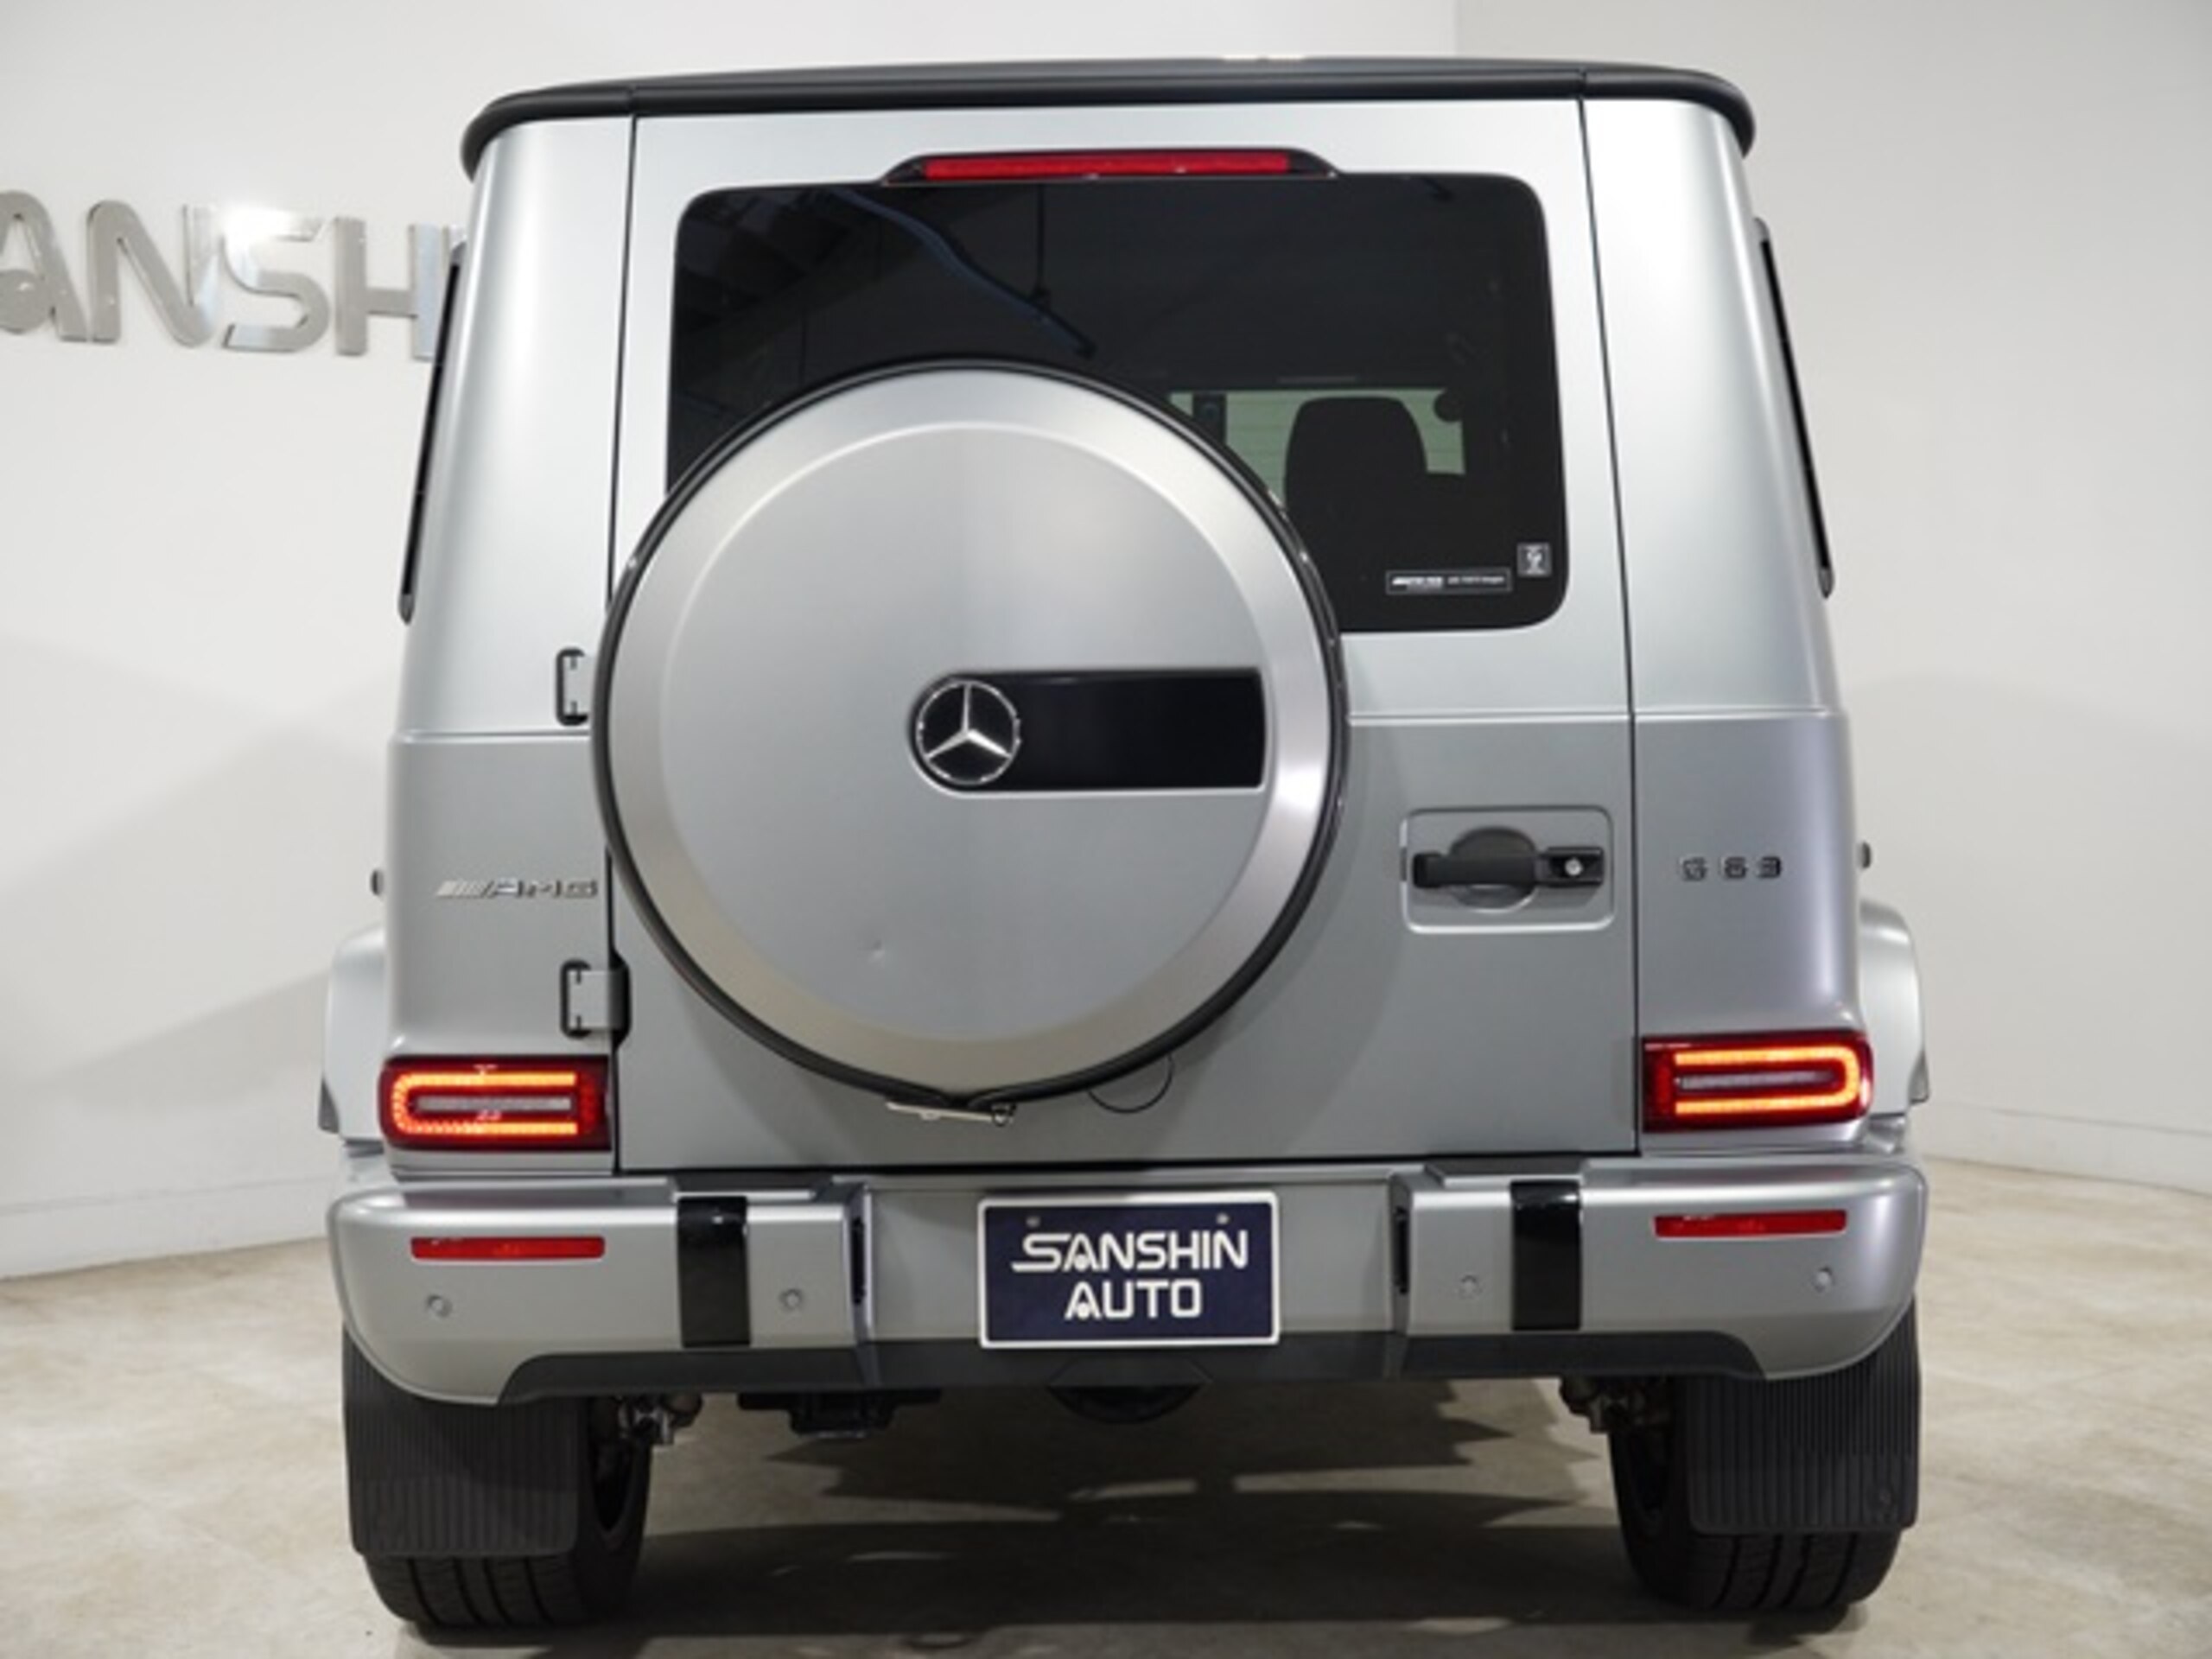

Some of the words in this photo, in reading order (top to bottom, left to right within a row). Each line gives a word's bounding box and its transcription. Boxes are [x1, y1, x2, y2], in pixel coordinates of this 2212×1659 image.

[0, 190, 465, 361] ANSH
[480, 879, 598, 899] AMG
[1011, 1230, 1249, 1273] SANSHIN
[1064, 1278, 1203, 1320] AUTO
